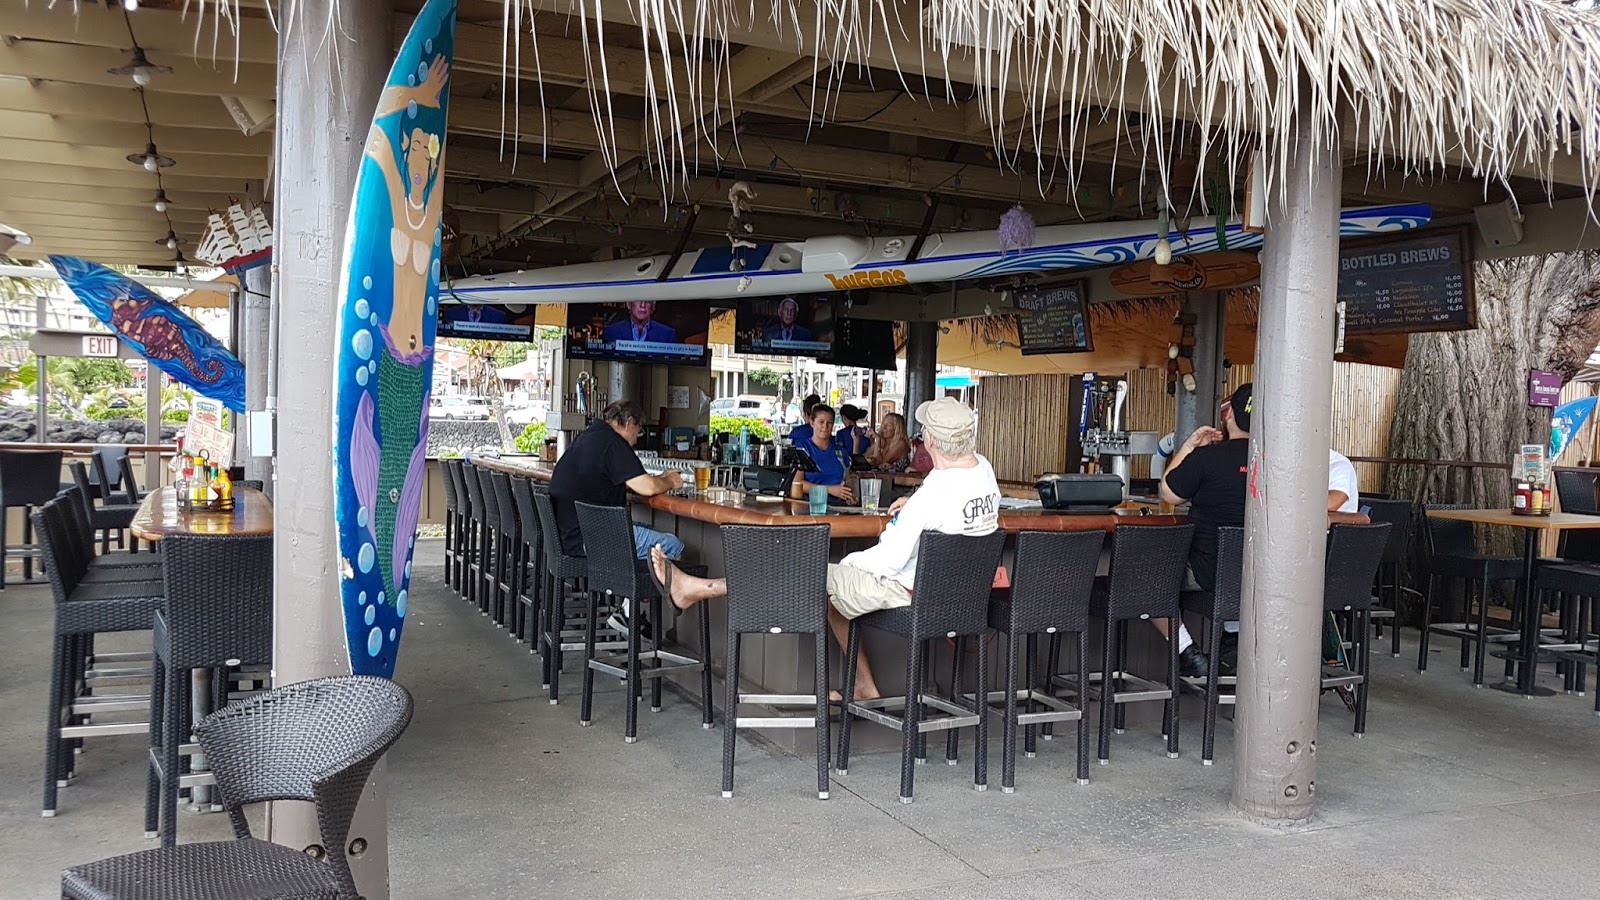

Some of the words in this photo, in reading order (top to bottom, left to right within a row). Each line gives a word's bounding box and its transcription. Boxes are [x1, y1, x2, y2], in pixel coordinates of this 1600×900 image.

[1341, 253, 1397, 271] BOTTLED
[1400, 246, 1450, 264] BREWS
[1019, 297, 1044, 311] DRAFT
[1046, 289, 1077, 305] BREWS
[89, 337, 113, 354] EXIT
[962, 492, 997, 525] GRAY
